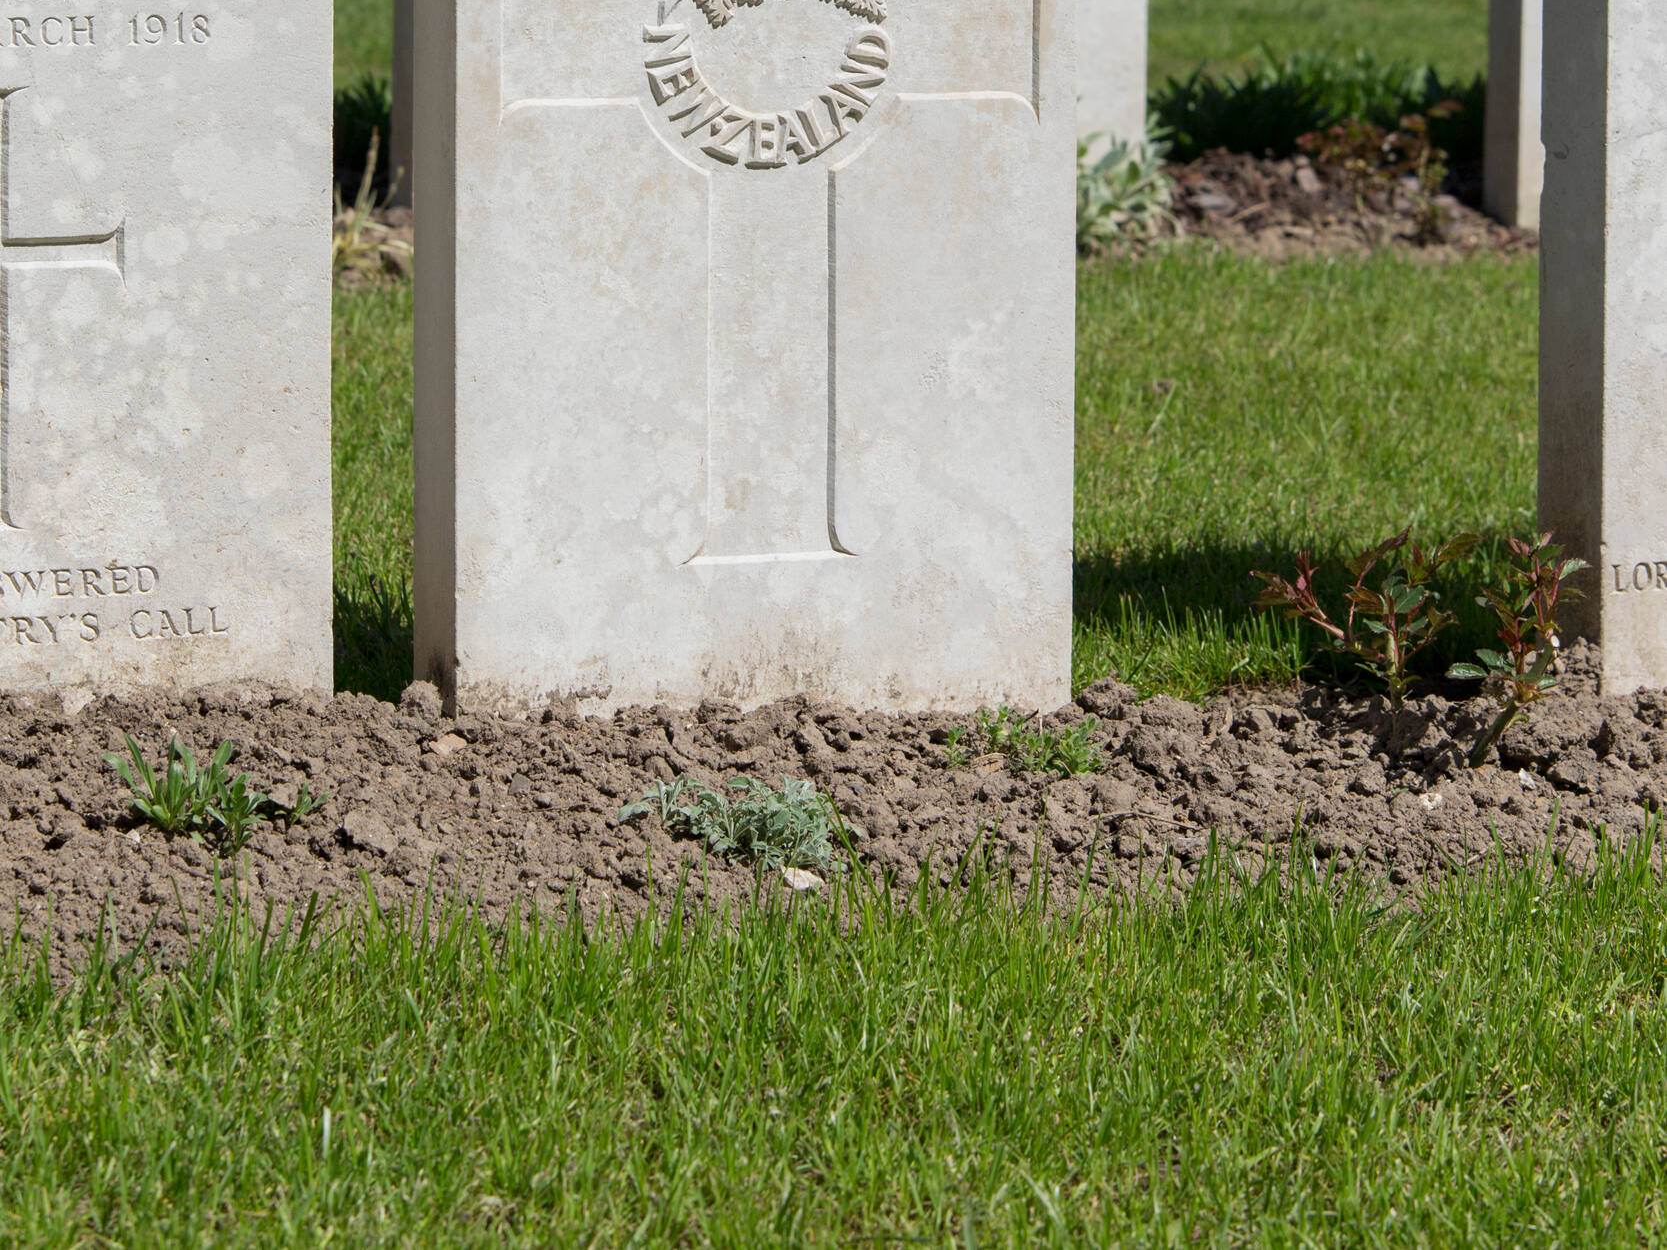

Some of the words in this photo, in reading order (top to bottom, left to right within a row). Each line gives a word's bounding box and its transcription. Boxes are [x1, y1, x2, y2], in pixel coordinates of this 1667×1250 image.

[0, 14, 96, 47] RCH
[128, 11, 211, 45] 1918
[642, 23, 730, 139] NEW
[699, 24, 891, 170] ZEALAND
[0, 565, 160, 597] WERED
[0, 612, 100, 646] RY'S
[129, 606, 229, 640] CALL
